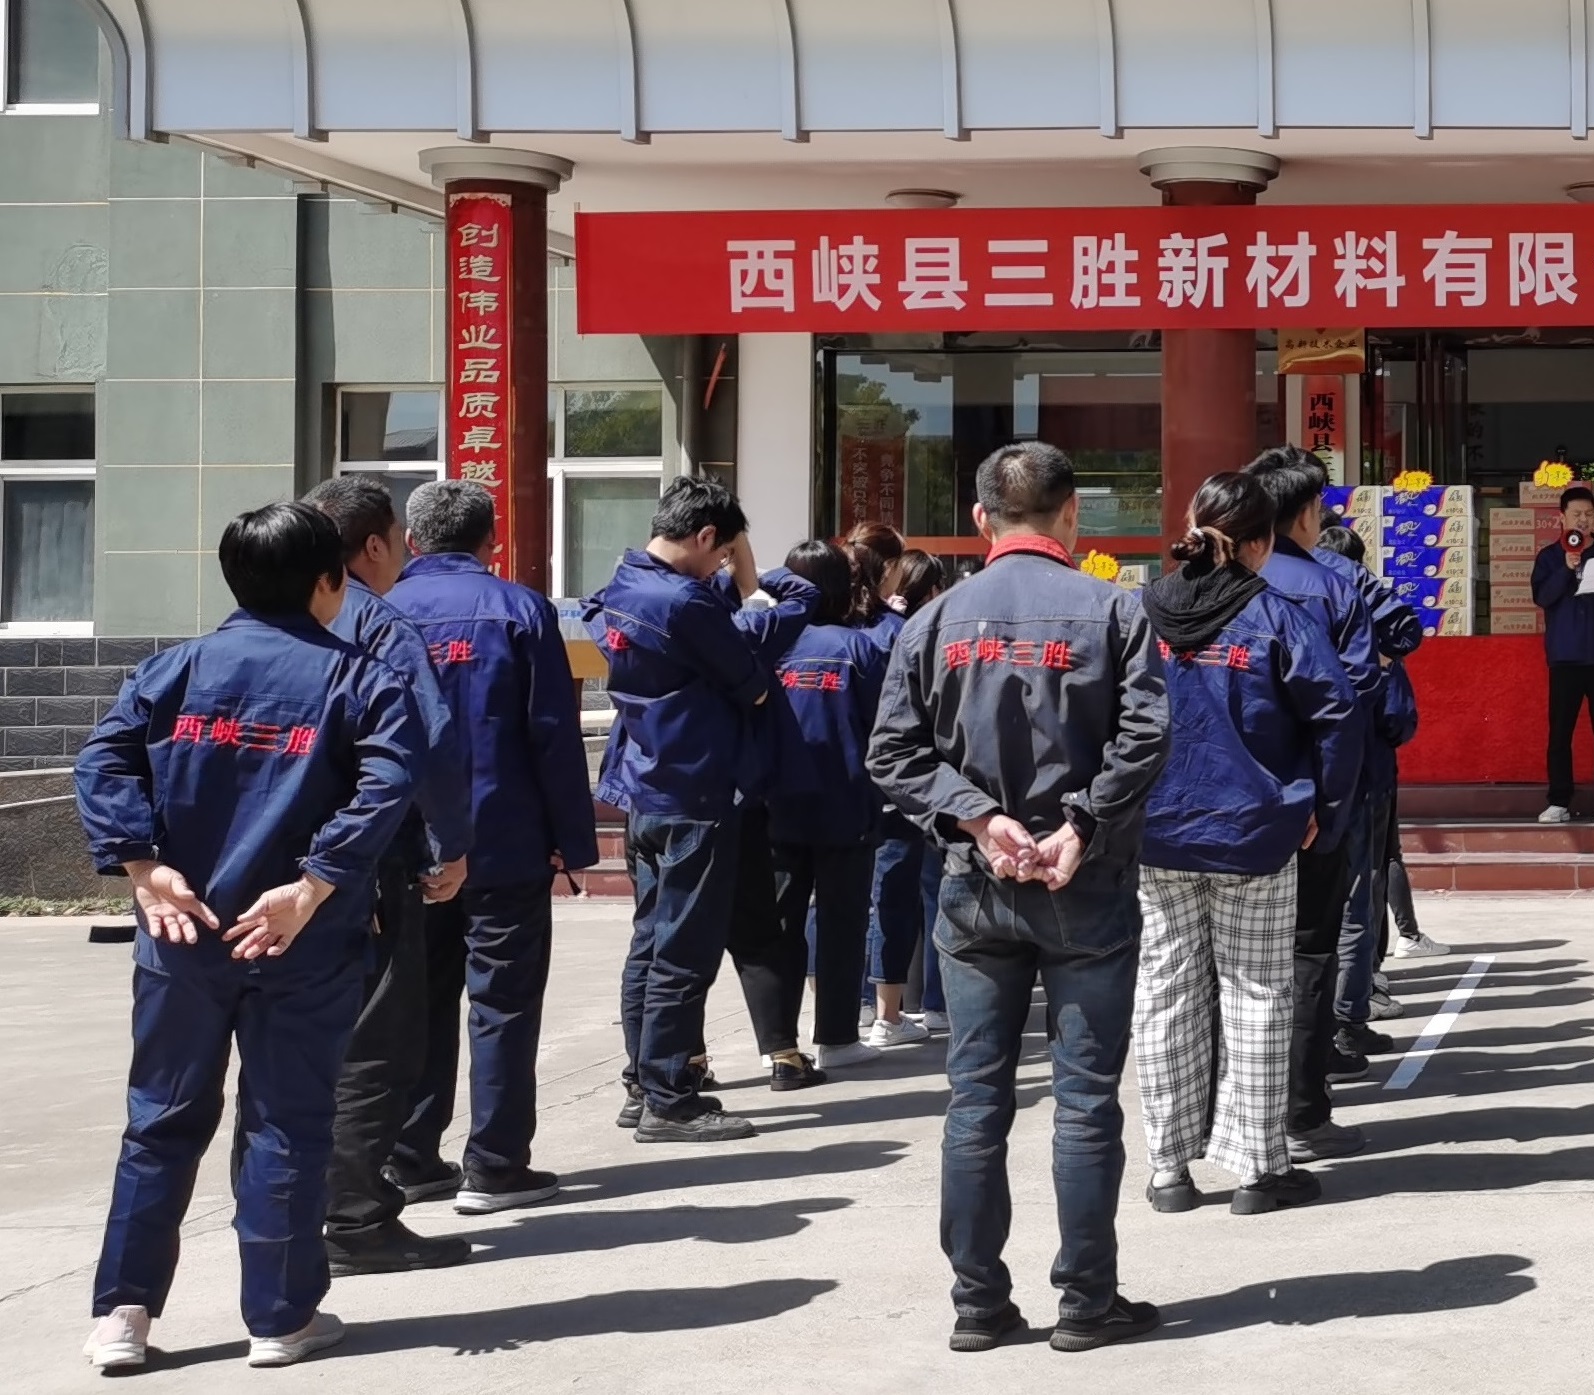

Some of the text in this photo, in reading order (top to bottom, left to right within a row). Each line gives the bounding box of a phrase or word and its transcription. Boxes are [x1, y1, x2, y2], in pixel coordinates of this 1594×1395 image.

[942, 635, 1073, 671] 西峡三胜
[172, 713, 317, 756] 西峡三胜
